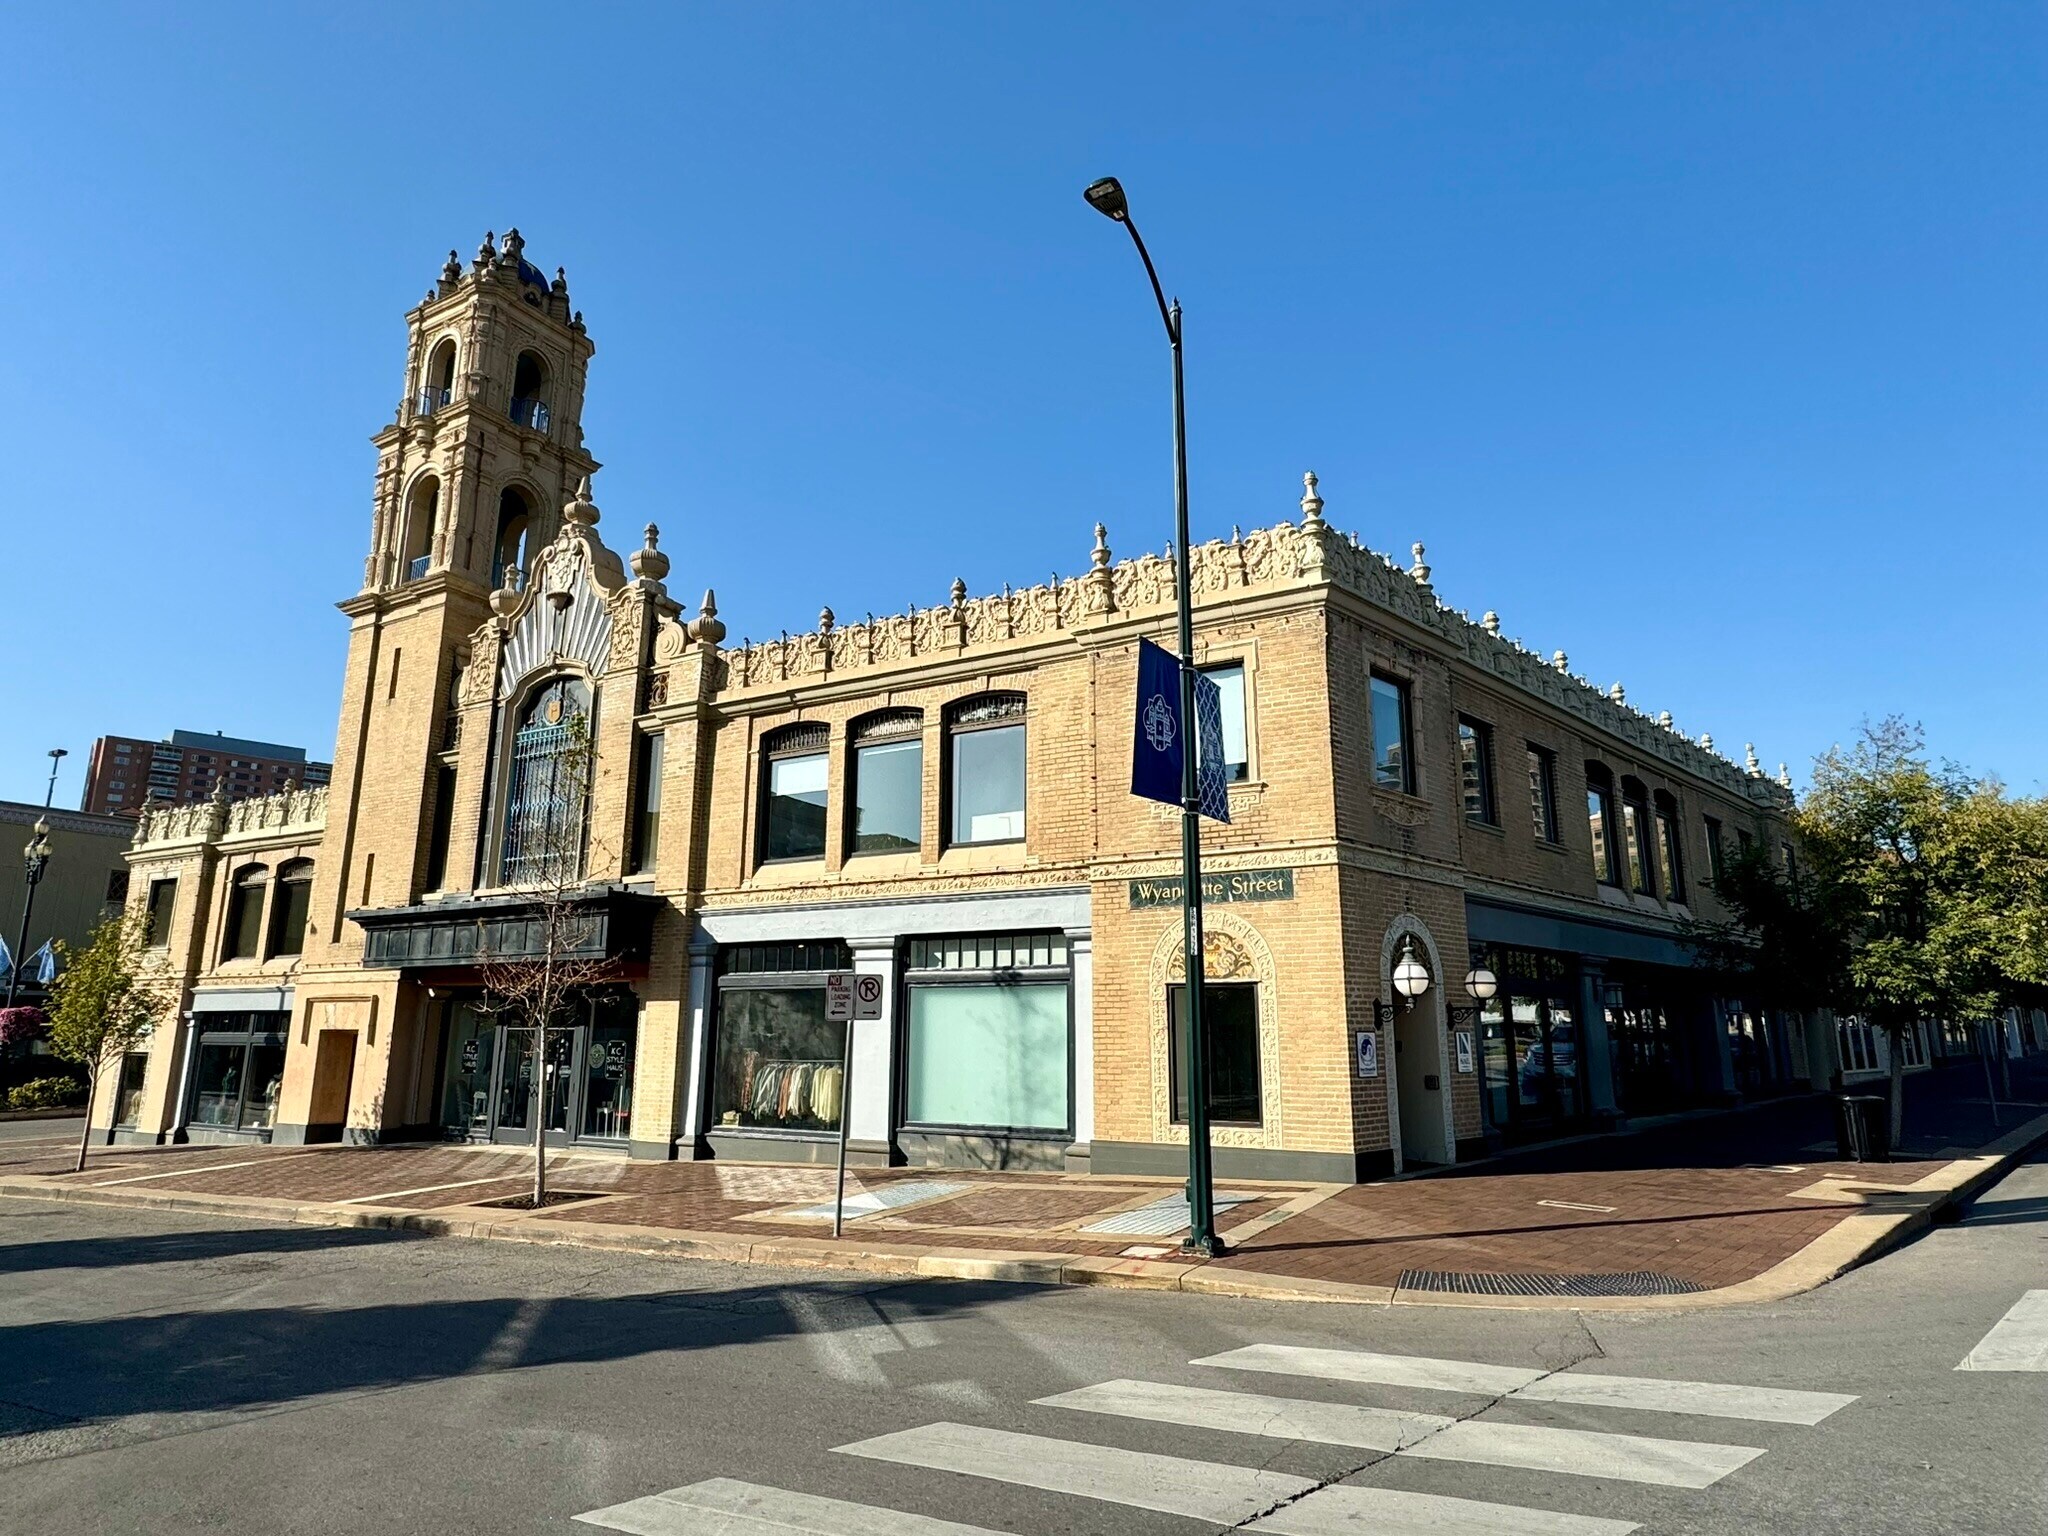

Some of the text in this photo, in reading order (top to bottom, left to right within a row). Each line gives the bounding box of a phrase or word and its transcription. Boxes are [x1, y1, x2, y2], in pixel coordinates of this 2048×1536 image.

[1138, 876, 1284, 905] Wyantte Street
[829, 975, 841, 985] NO
[834, 1001, 847, 1009] ZONE
[610, 1047, 622, 1056] KC
[606, 1056, 625, 1064] STYLE
[606, 1064, 623, 1072] HAUS
